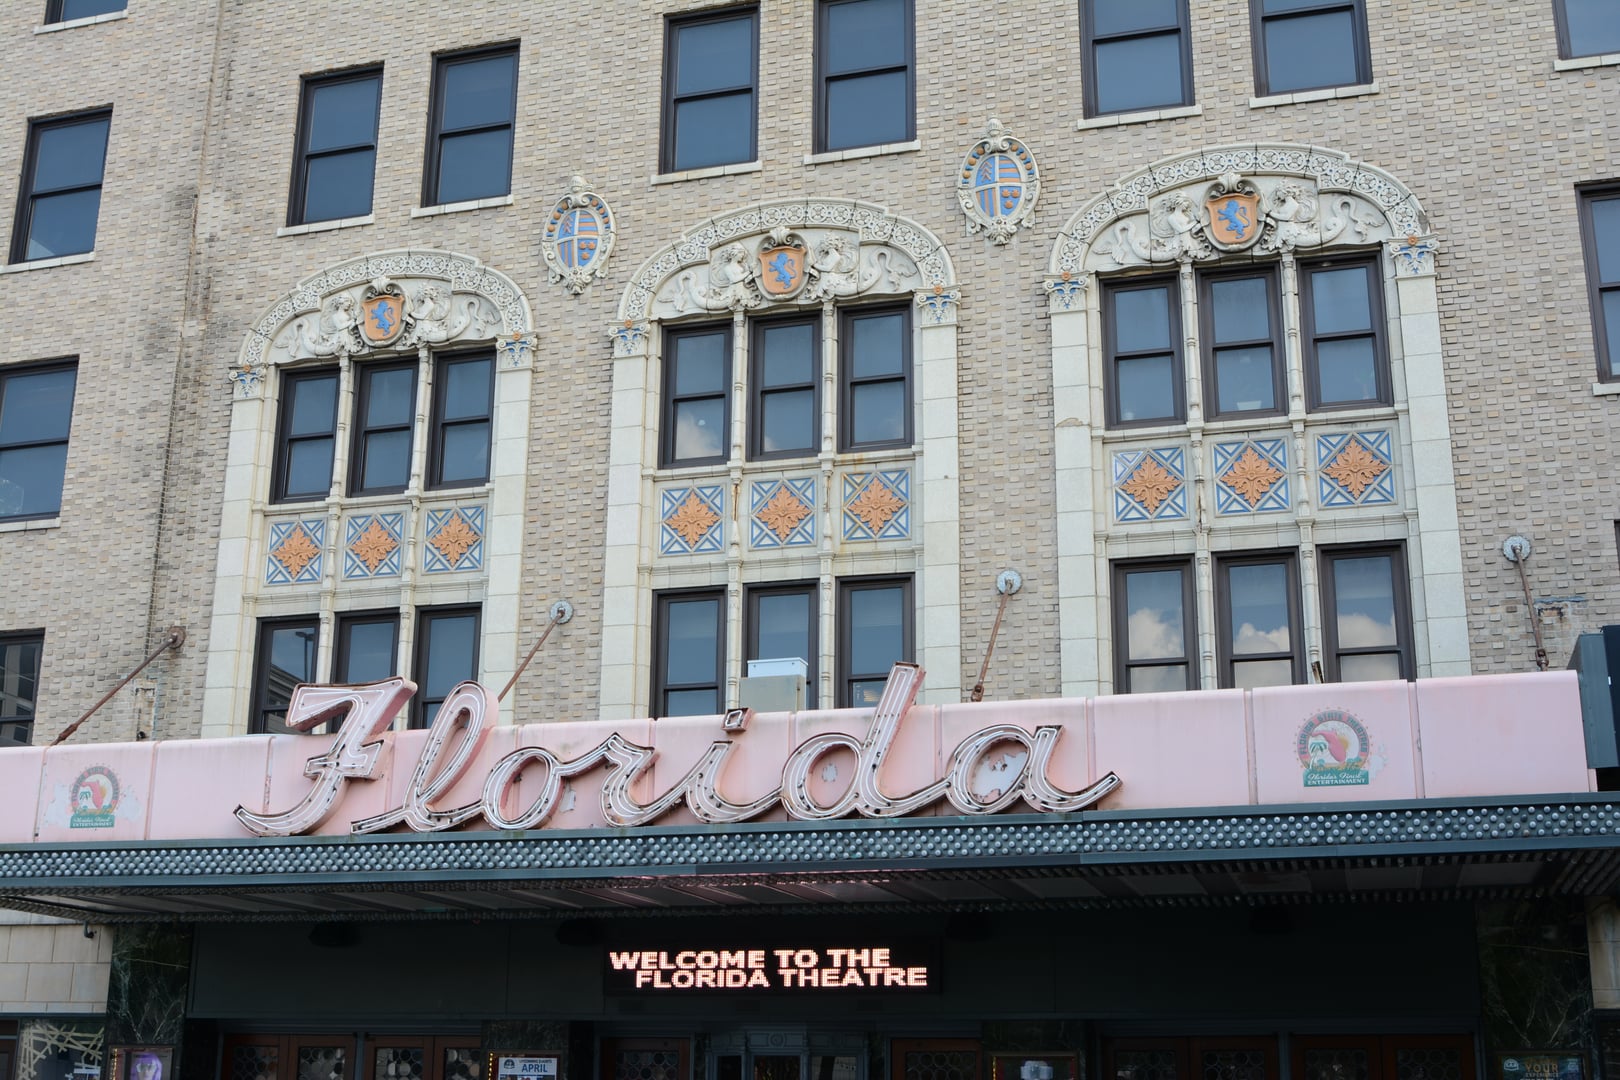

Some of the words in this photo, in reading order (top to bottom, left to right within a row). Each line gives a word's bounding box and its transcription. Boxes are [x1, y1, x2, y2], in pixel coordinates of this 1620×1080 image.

[234, 661, 1122, 836] Florida
[609, 950, 765, 970] WELCOME
[773, 949, 819, 968] TO
[826, 948, 890, 967] THE
[636, 969, 770, 988] FLORIDA
[777, 967, 927, 987] THEATRE
[521, 1064, 548, 1073] APRIL
[1525, 1064, 1558, 1073] YOUR
